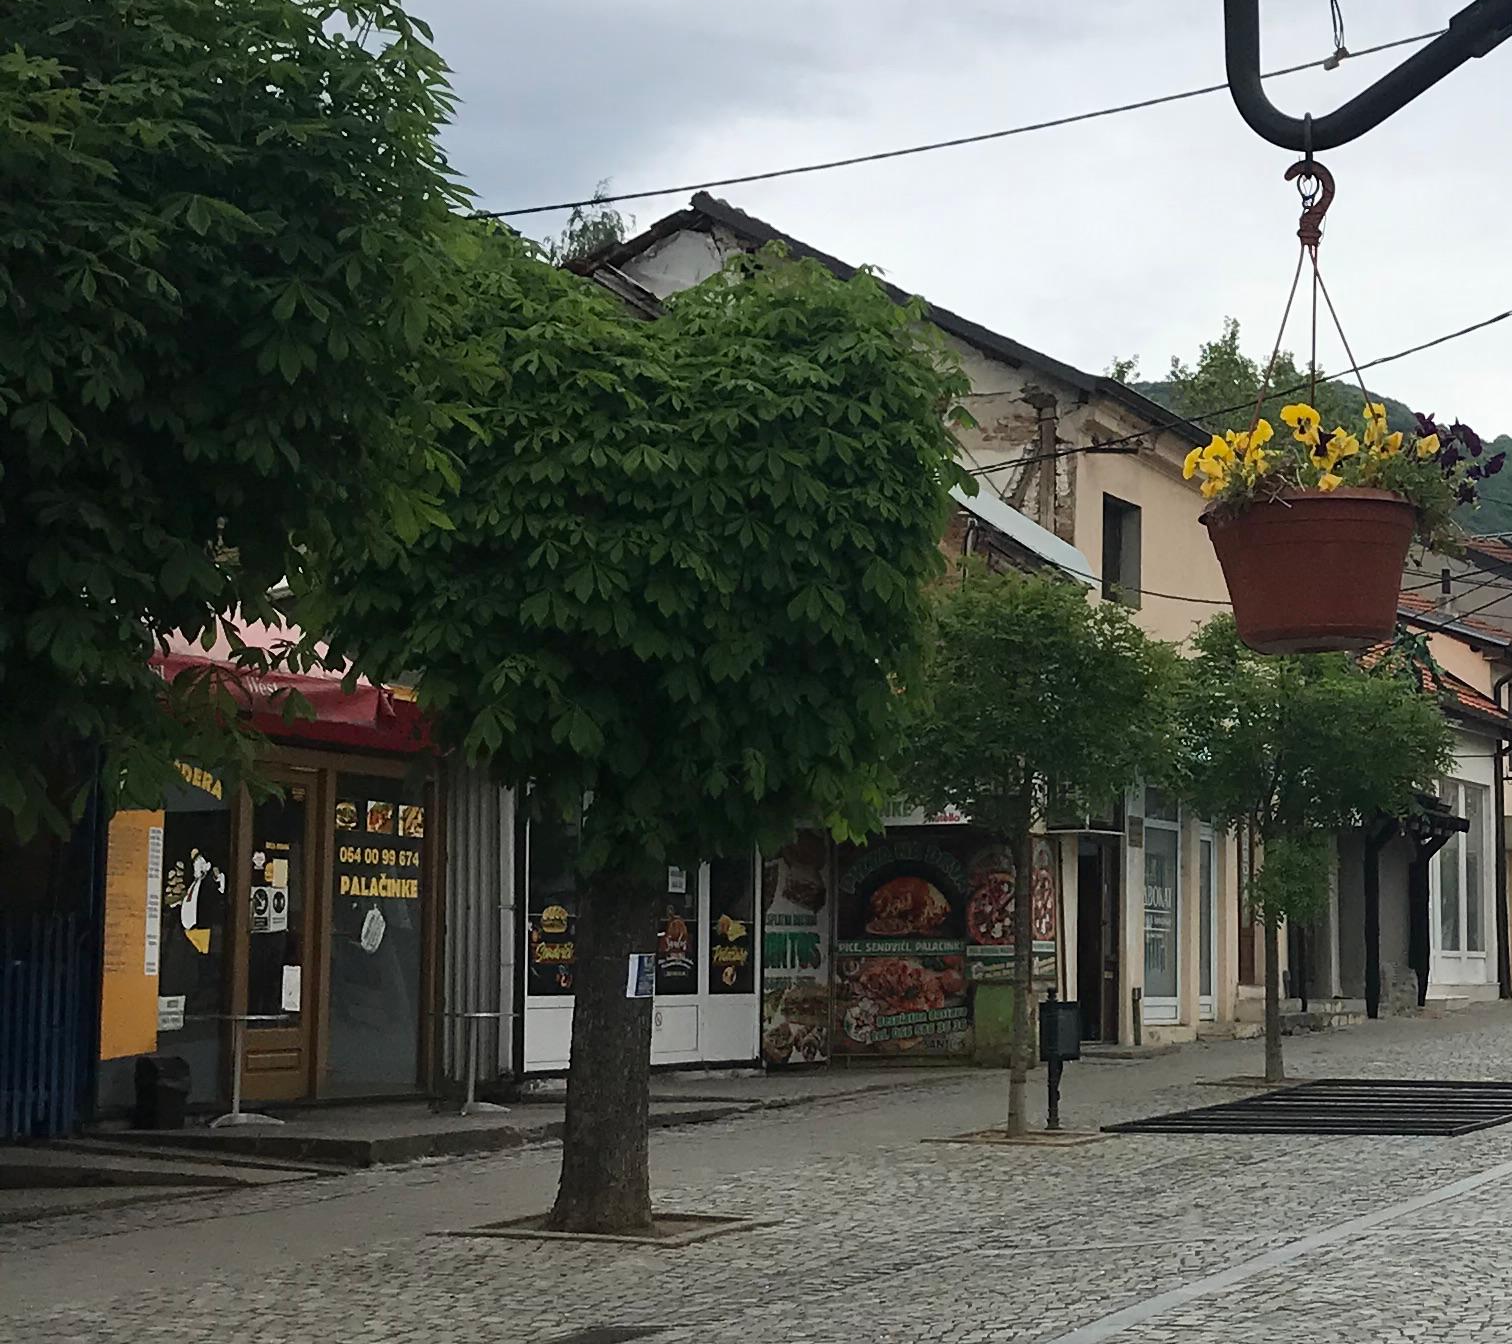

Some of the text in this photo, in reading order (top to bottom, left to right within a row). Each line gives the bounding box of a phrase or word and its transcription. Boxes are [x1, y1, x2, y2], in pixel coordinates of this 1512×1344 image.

[339, 846, 420, 868] 064 00 99 674
[340, 873, 418, 898] PALAČINKE
